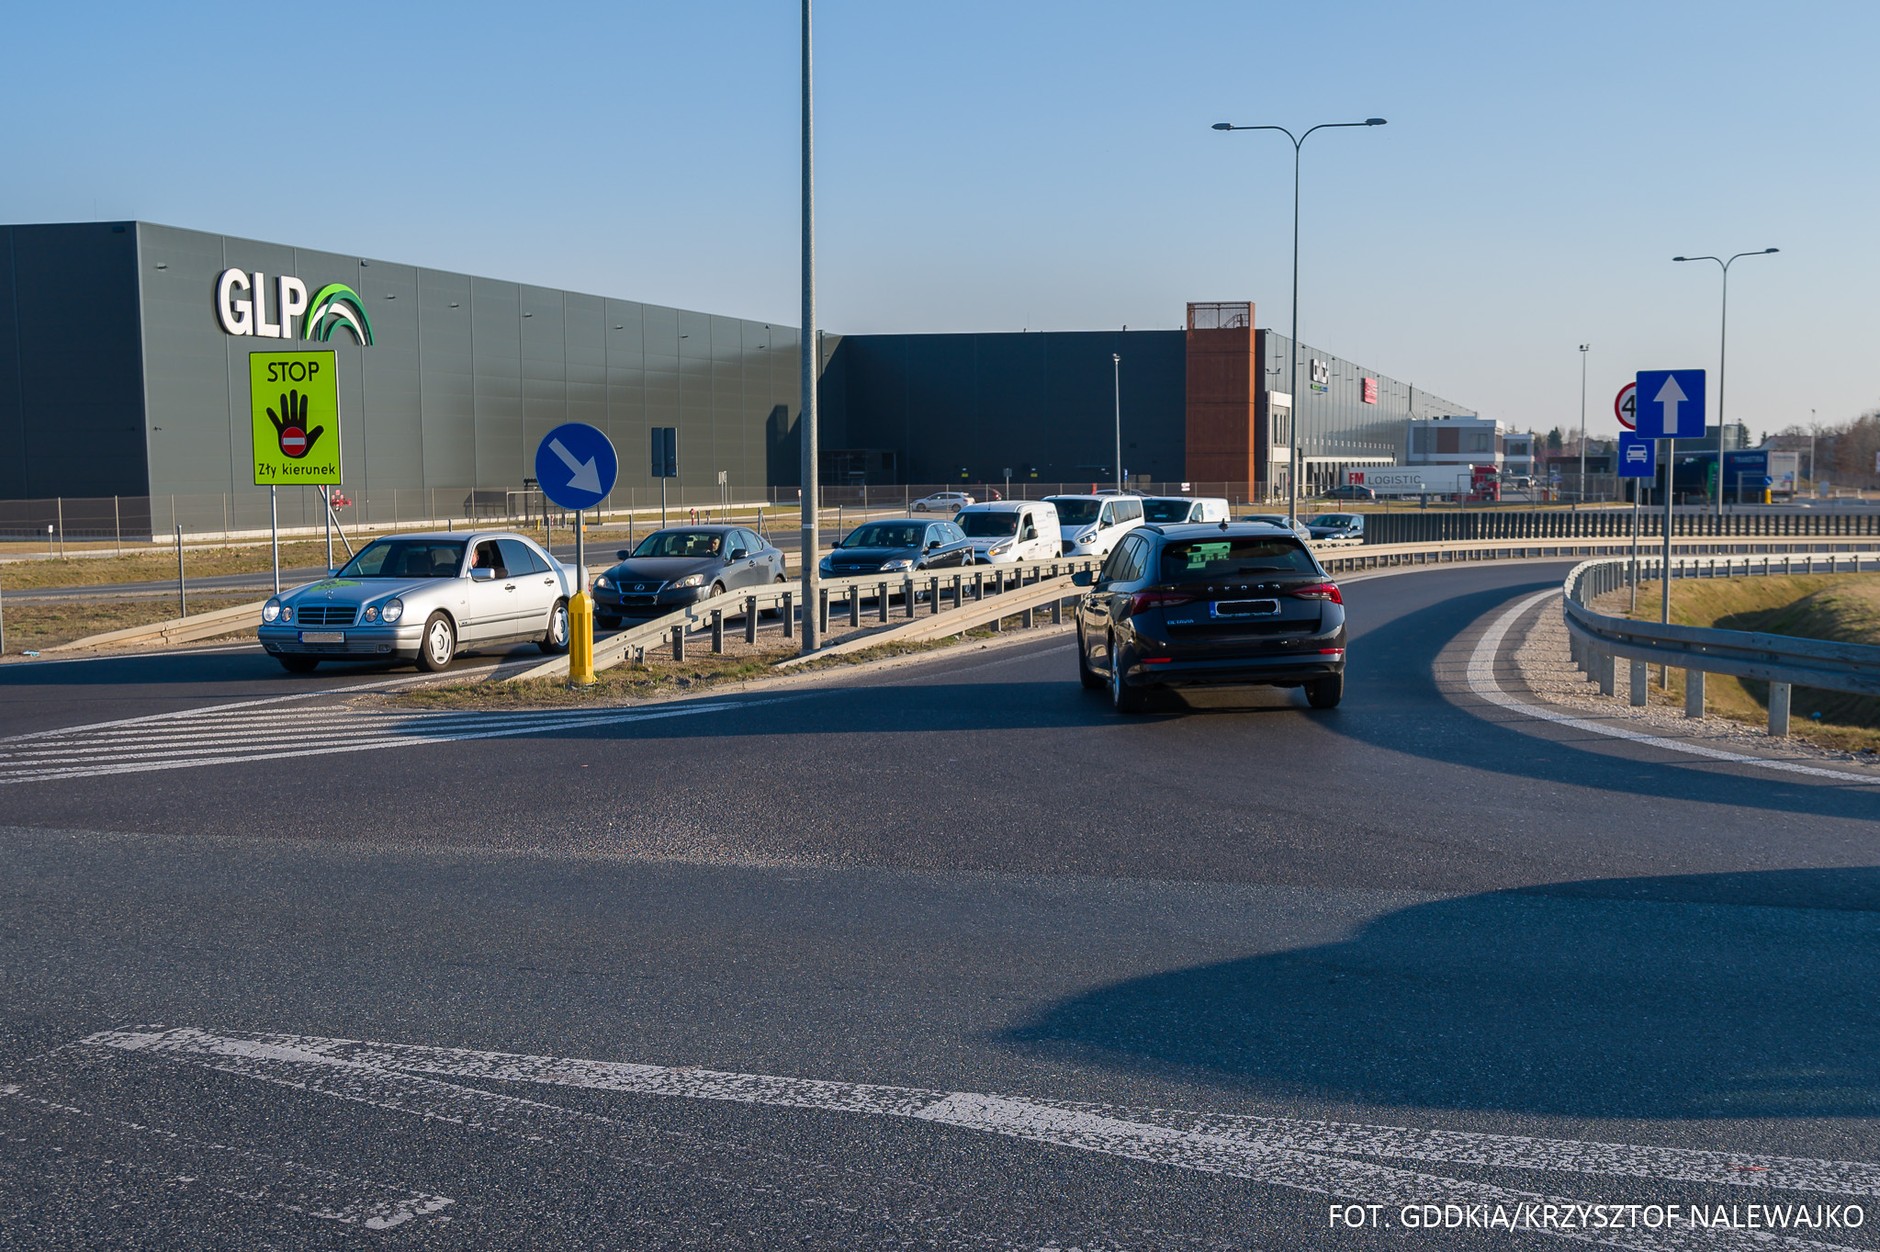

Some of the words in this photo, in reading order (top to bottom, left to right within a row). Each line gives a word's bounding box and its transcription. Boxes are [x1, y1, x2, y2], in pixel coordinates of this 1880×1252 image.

[217, 268, 308, 339] GLP
[267, 361, 320, 382] STOP
[1621, 394, 1636, 418] 4
[258, 463, 277, 479] Zły
[282, 463, 336, 476] kierunek
[1349, 472, 1365, 485] FM
[1368, 475, 1421, 485] LOGISTIC
